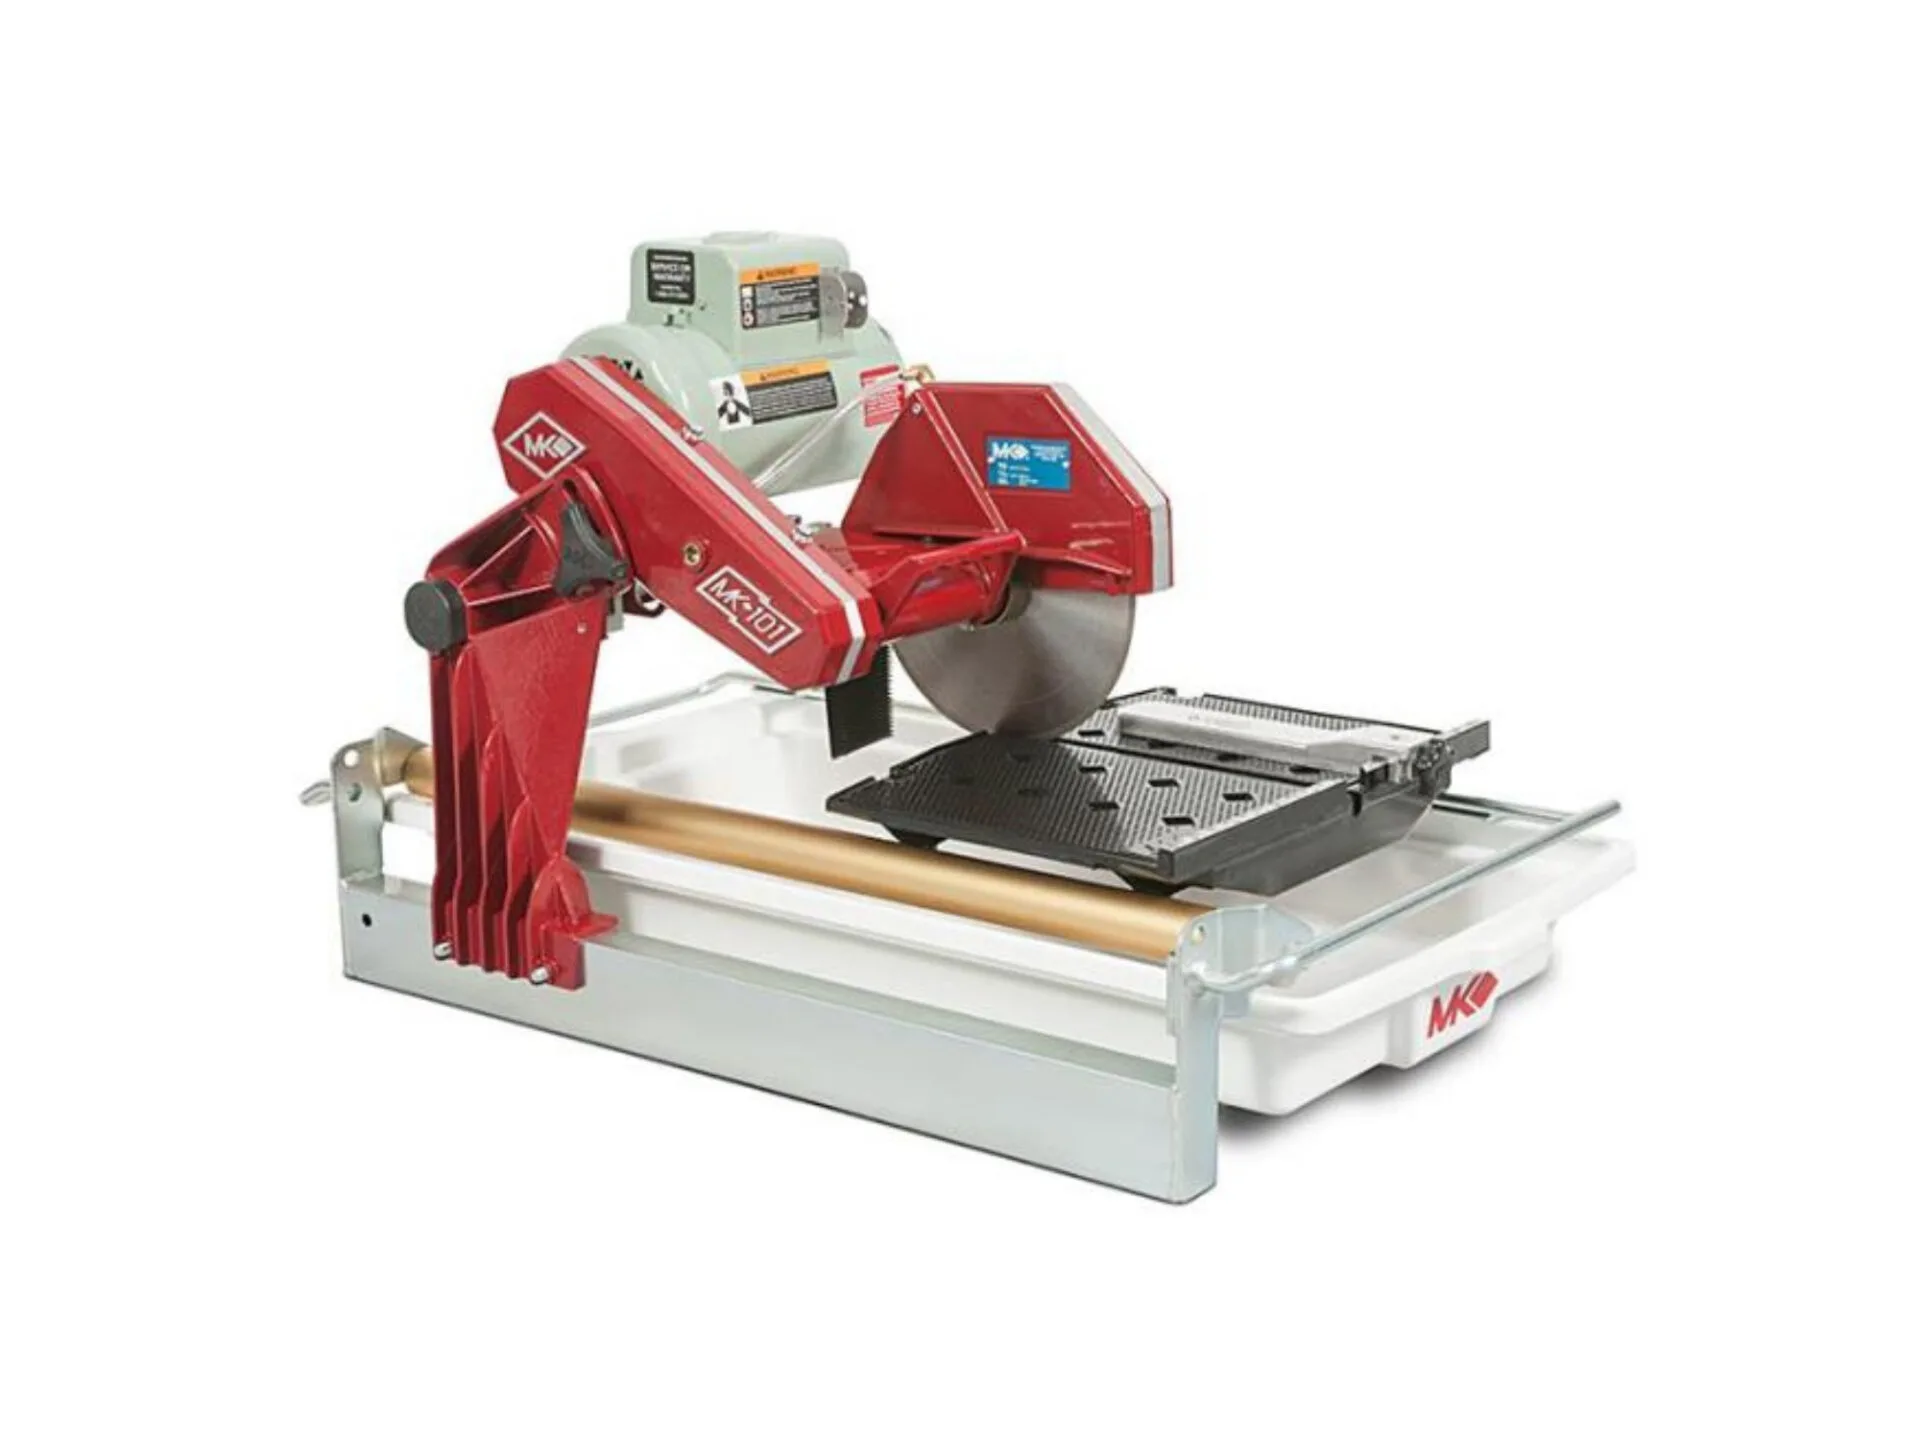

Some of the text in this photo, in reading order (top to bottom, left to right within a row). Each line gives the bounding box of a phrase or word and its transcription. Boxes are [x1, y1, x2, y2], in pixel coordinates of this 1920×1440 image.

[523, 432, 559, 459] MK
[709, 577, 786, 640] MK-101
[1427, 972, 1482, 1039] MK
